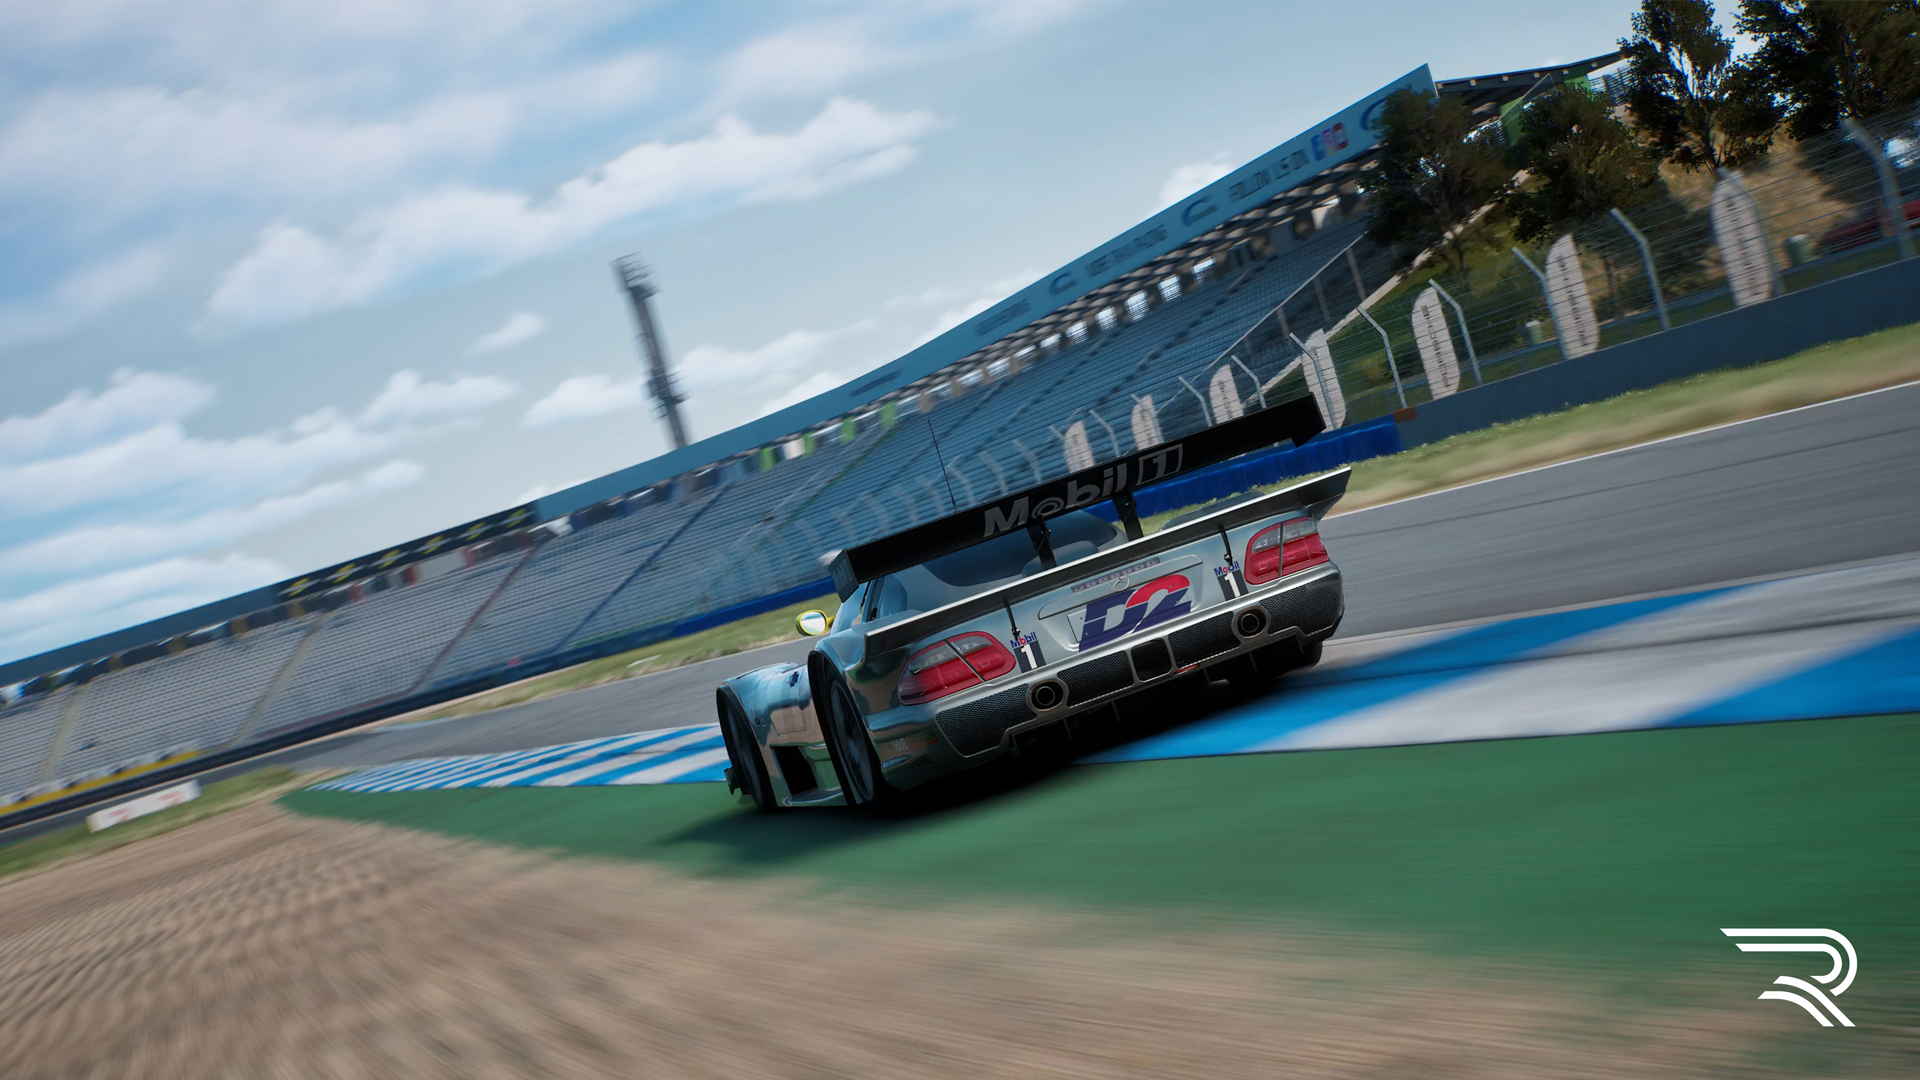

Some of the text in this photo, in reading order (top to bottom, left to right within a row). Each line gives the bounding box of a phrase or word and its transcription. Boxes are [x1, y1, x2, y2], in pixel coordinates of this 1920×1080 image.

[984, 463, 1127, 538] Mobil
[1224, 572, 1241, 598] 1
[1079, 574, 1192, 652] D2
[1010, 631, 1038, 648] Mobil
[1020, 643, 1038, 670] 1
